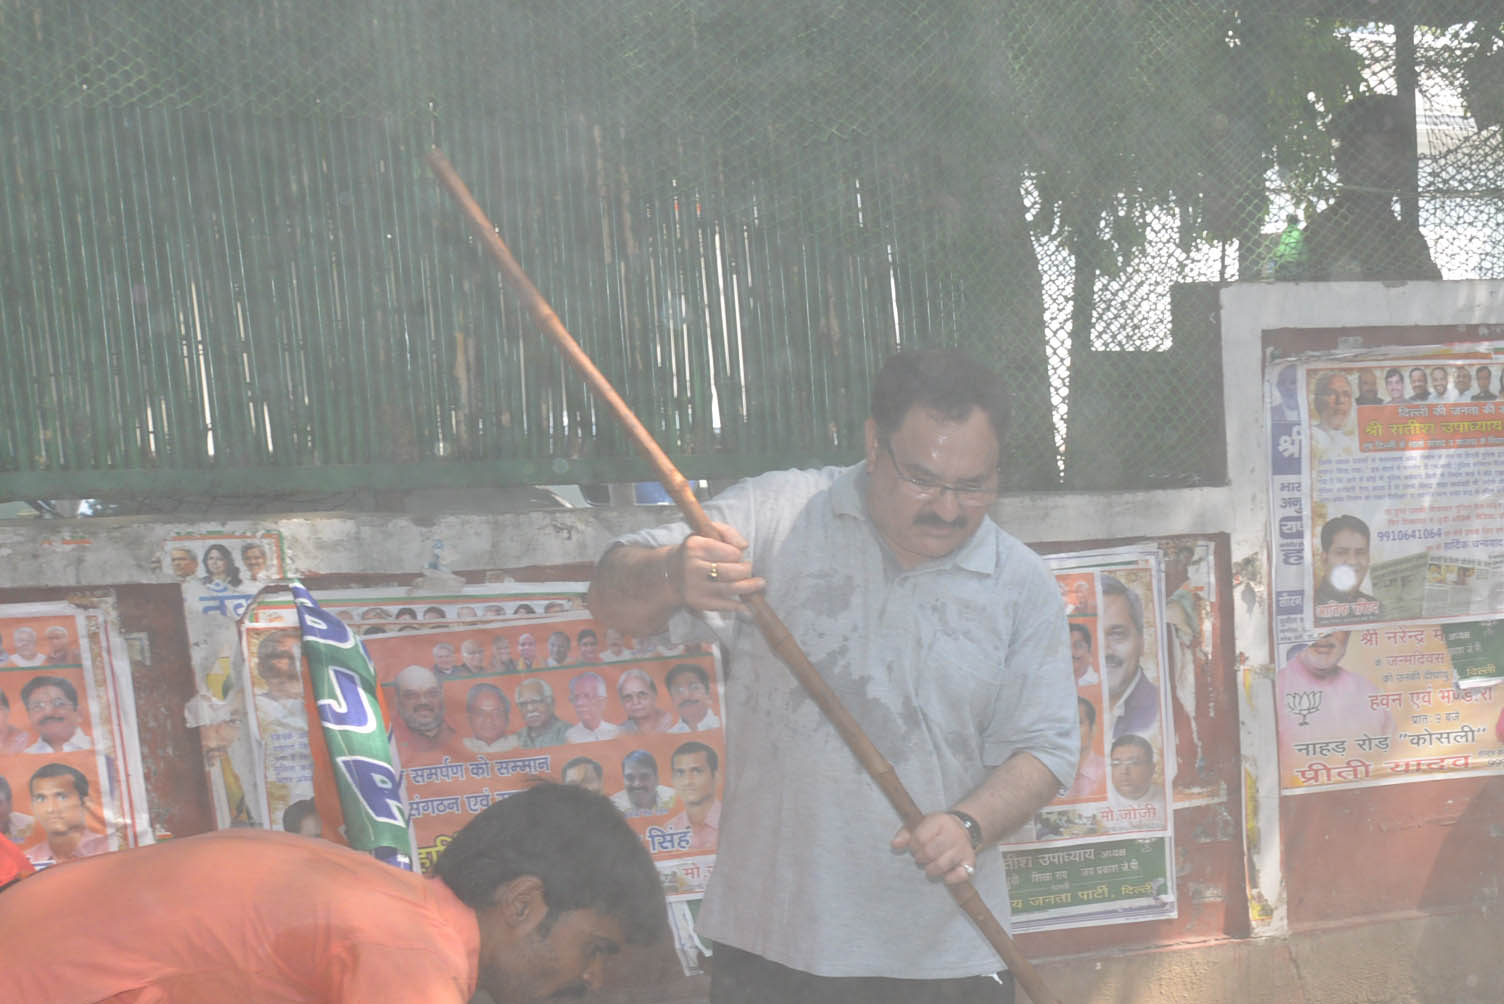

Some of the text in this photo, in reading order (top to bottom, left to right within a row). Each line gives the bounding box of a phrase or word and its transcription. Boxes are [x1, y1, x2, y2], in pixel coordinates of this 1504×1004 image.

[1365, 420, 1383, 437] श्री
[1389, 418, 1434, 435] सतीश
[1440, 418, 1503, 433] उपाध्याय
[1377, 527, 1443, 543] 9910641064
[1361, 628, 1379, 646] श्री
[1385, 626, 1425, 645] नरेन्द्र
[1368, 691, 1404, 710] हवन
[1408, 688, 1432, 708] एवं
[1294, 740, 1346, 757] नाहड़
[411, 755, 550, 785] समर्पण को सम्मान
[1296, 759, 1372, 784] प्रीती
[1384, 754, 1473, 773] यादव
[408, 794, 460, 818] संगठन
[465, 788, 491, 813] एवं
[1039, 848, 1095, 867] उपाध्याय
[1029, 891, 1072, 907] जनता
[1121, 882, 1153, 897] दिल्ली
